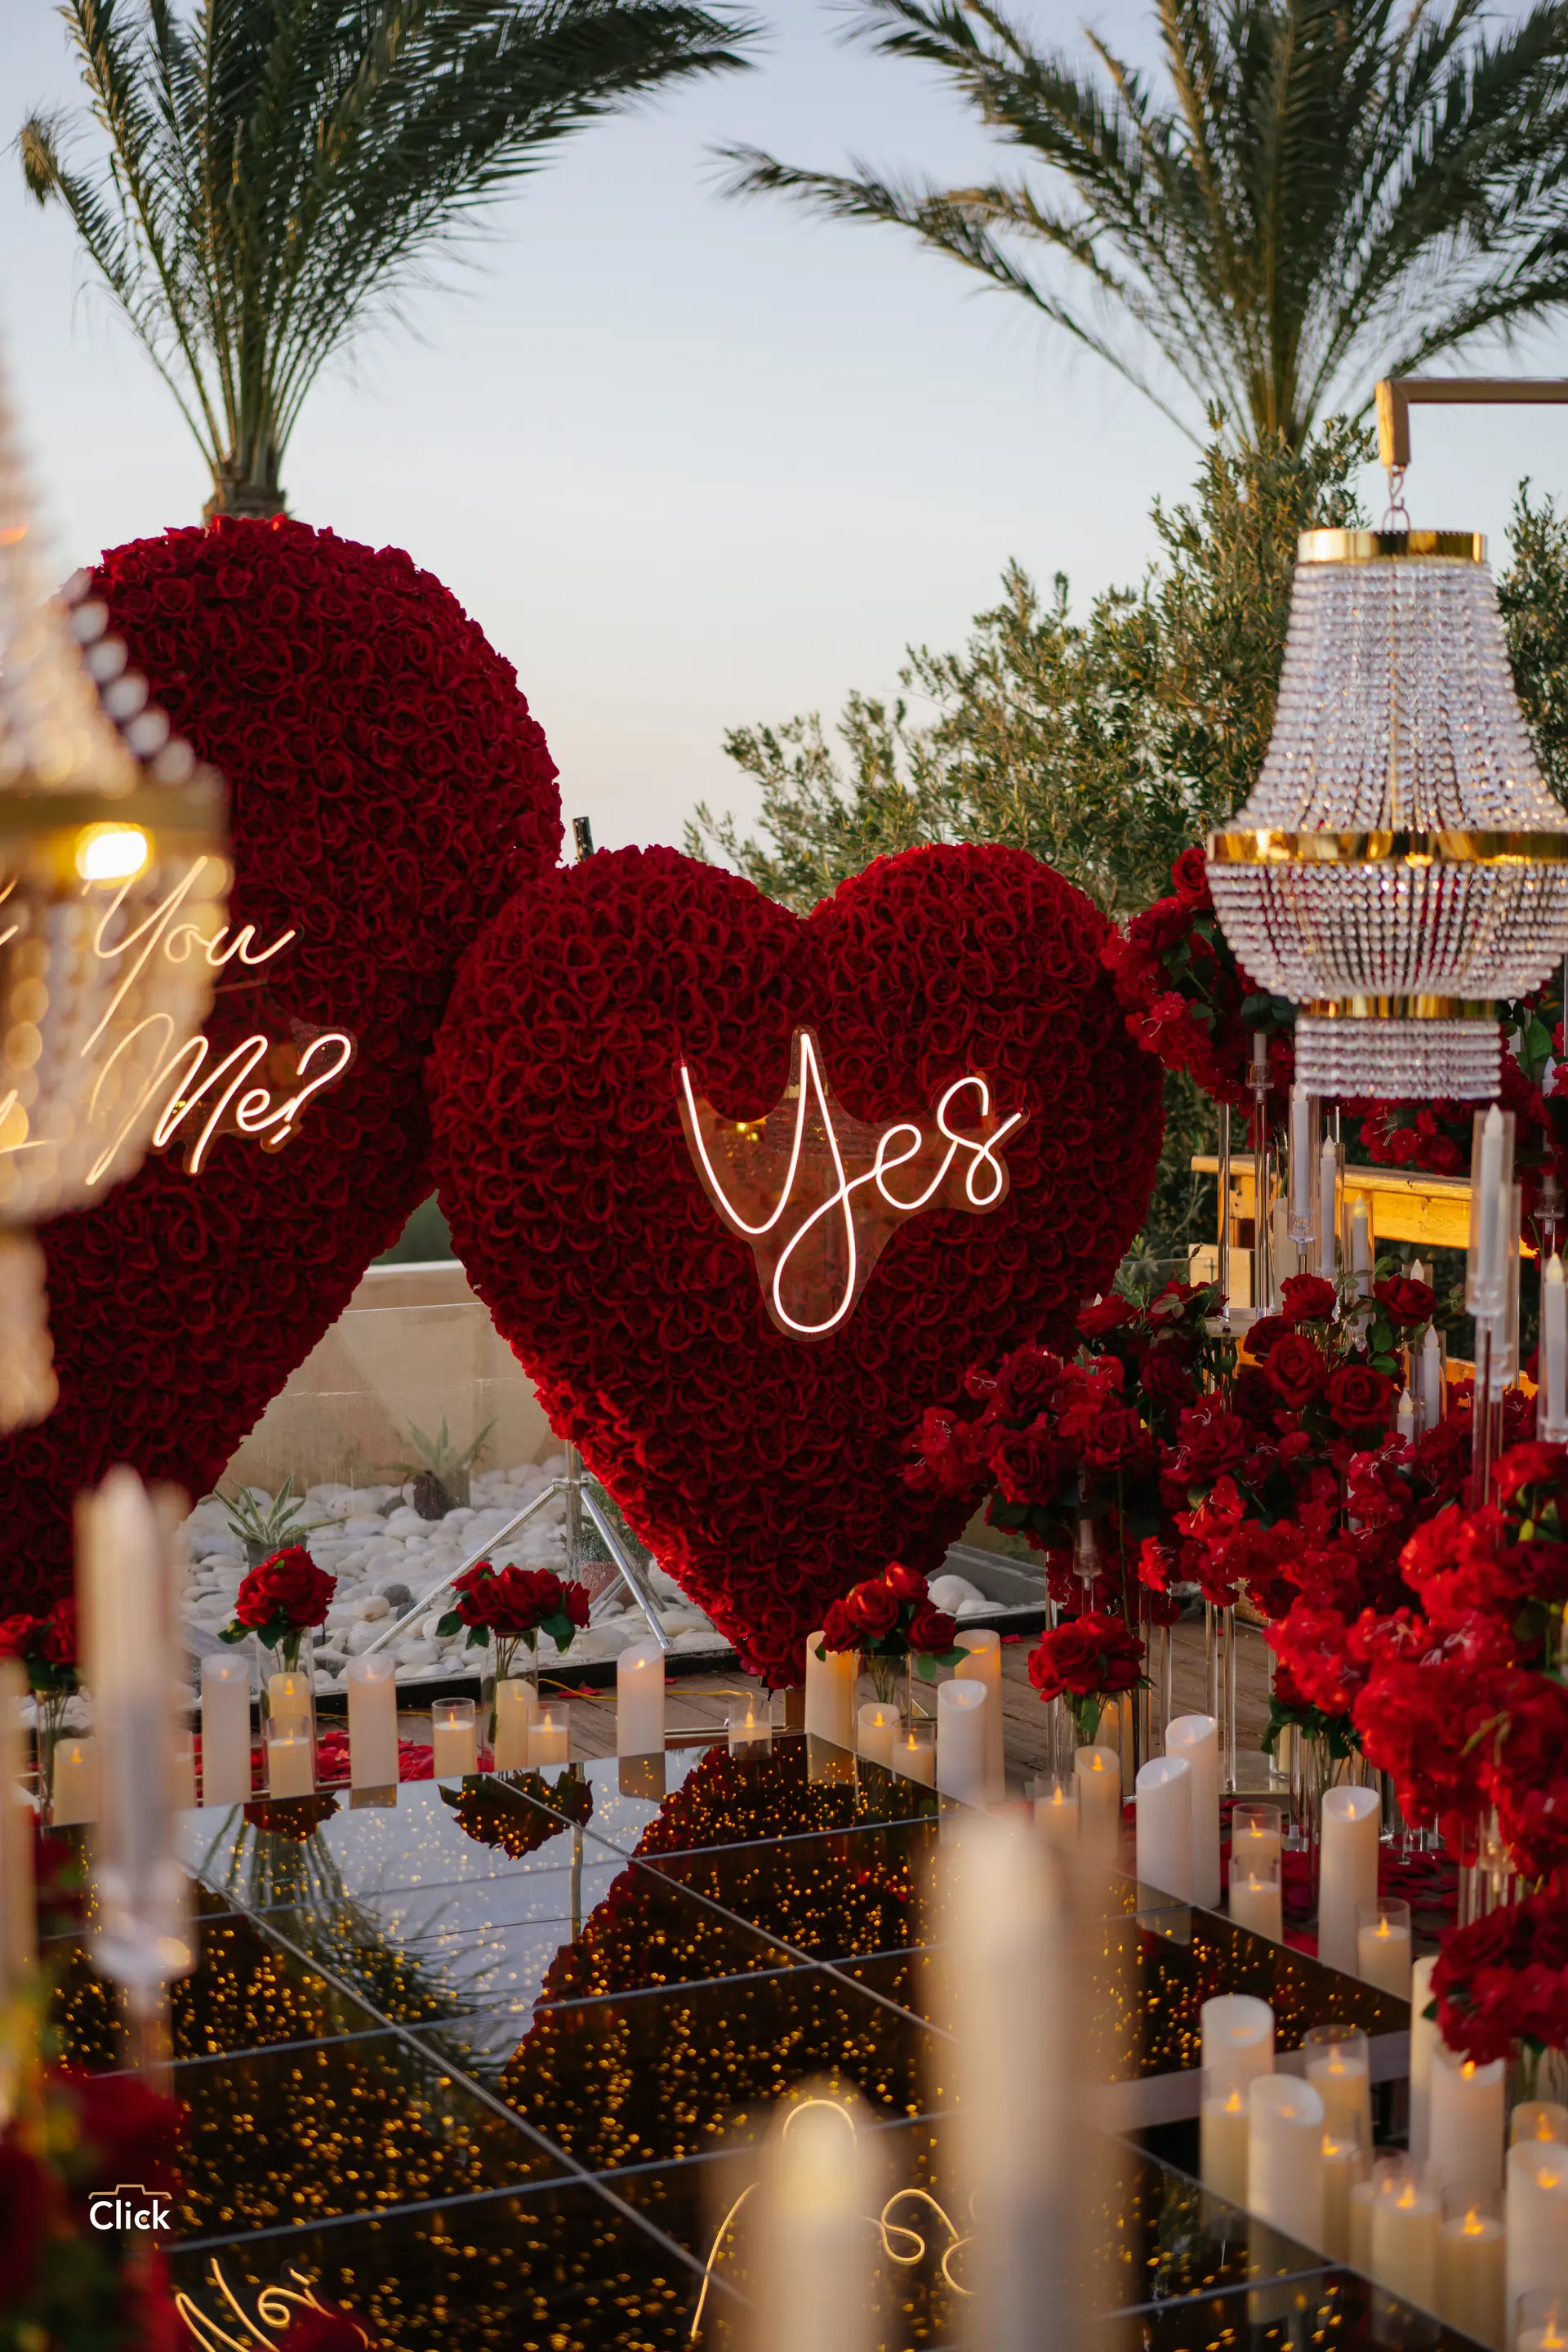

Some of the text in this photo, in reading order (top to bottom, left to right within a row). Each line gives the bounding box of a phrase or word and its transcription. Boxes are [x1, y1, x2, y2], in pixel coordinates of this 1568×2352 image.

[81, 854, 297, 1058] You
[86, 1012, 351, 1186] Me?
[680, 1032, 1022, 1334] Yes
